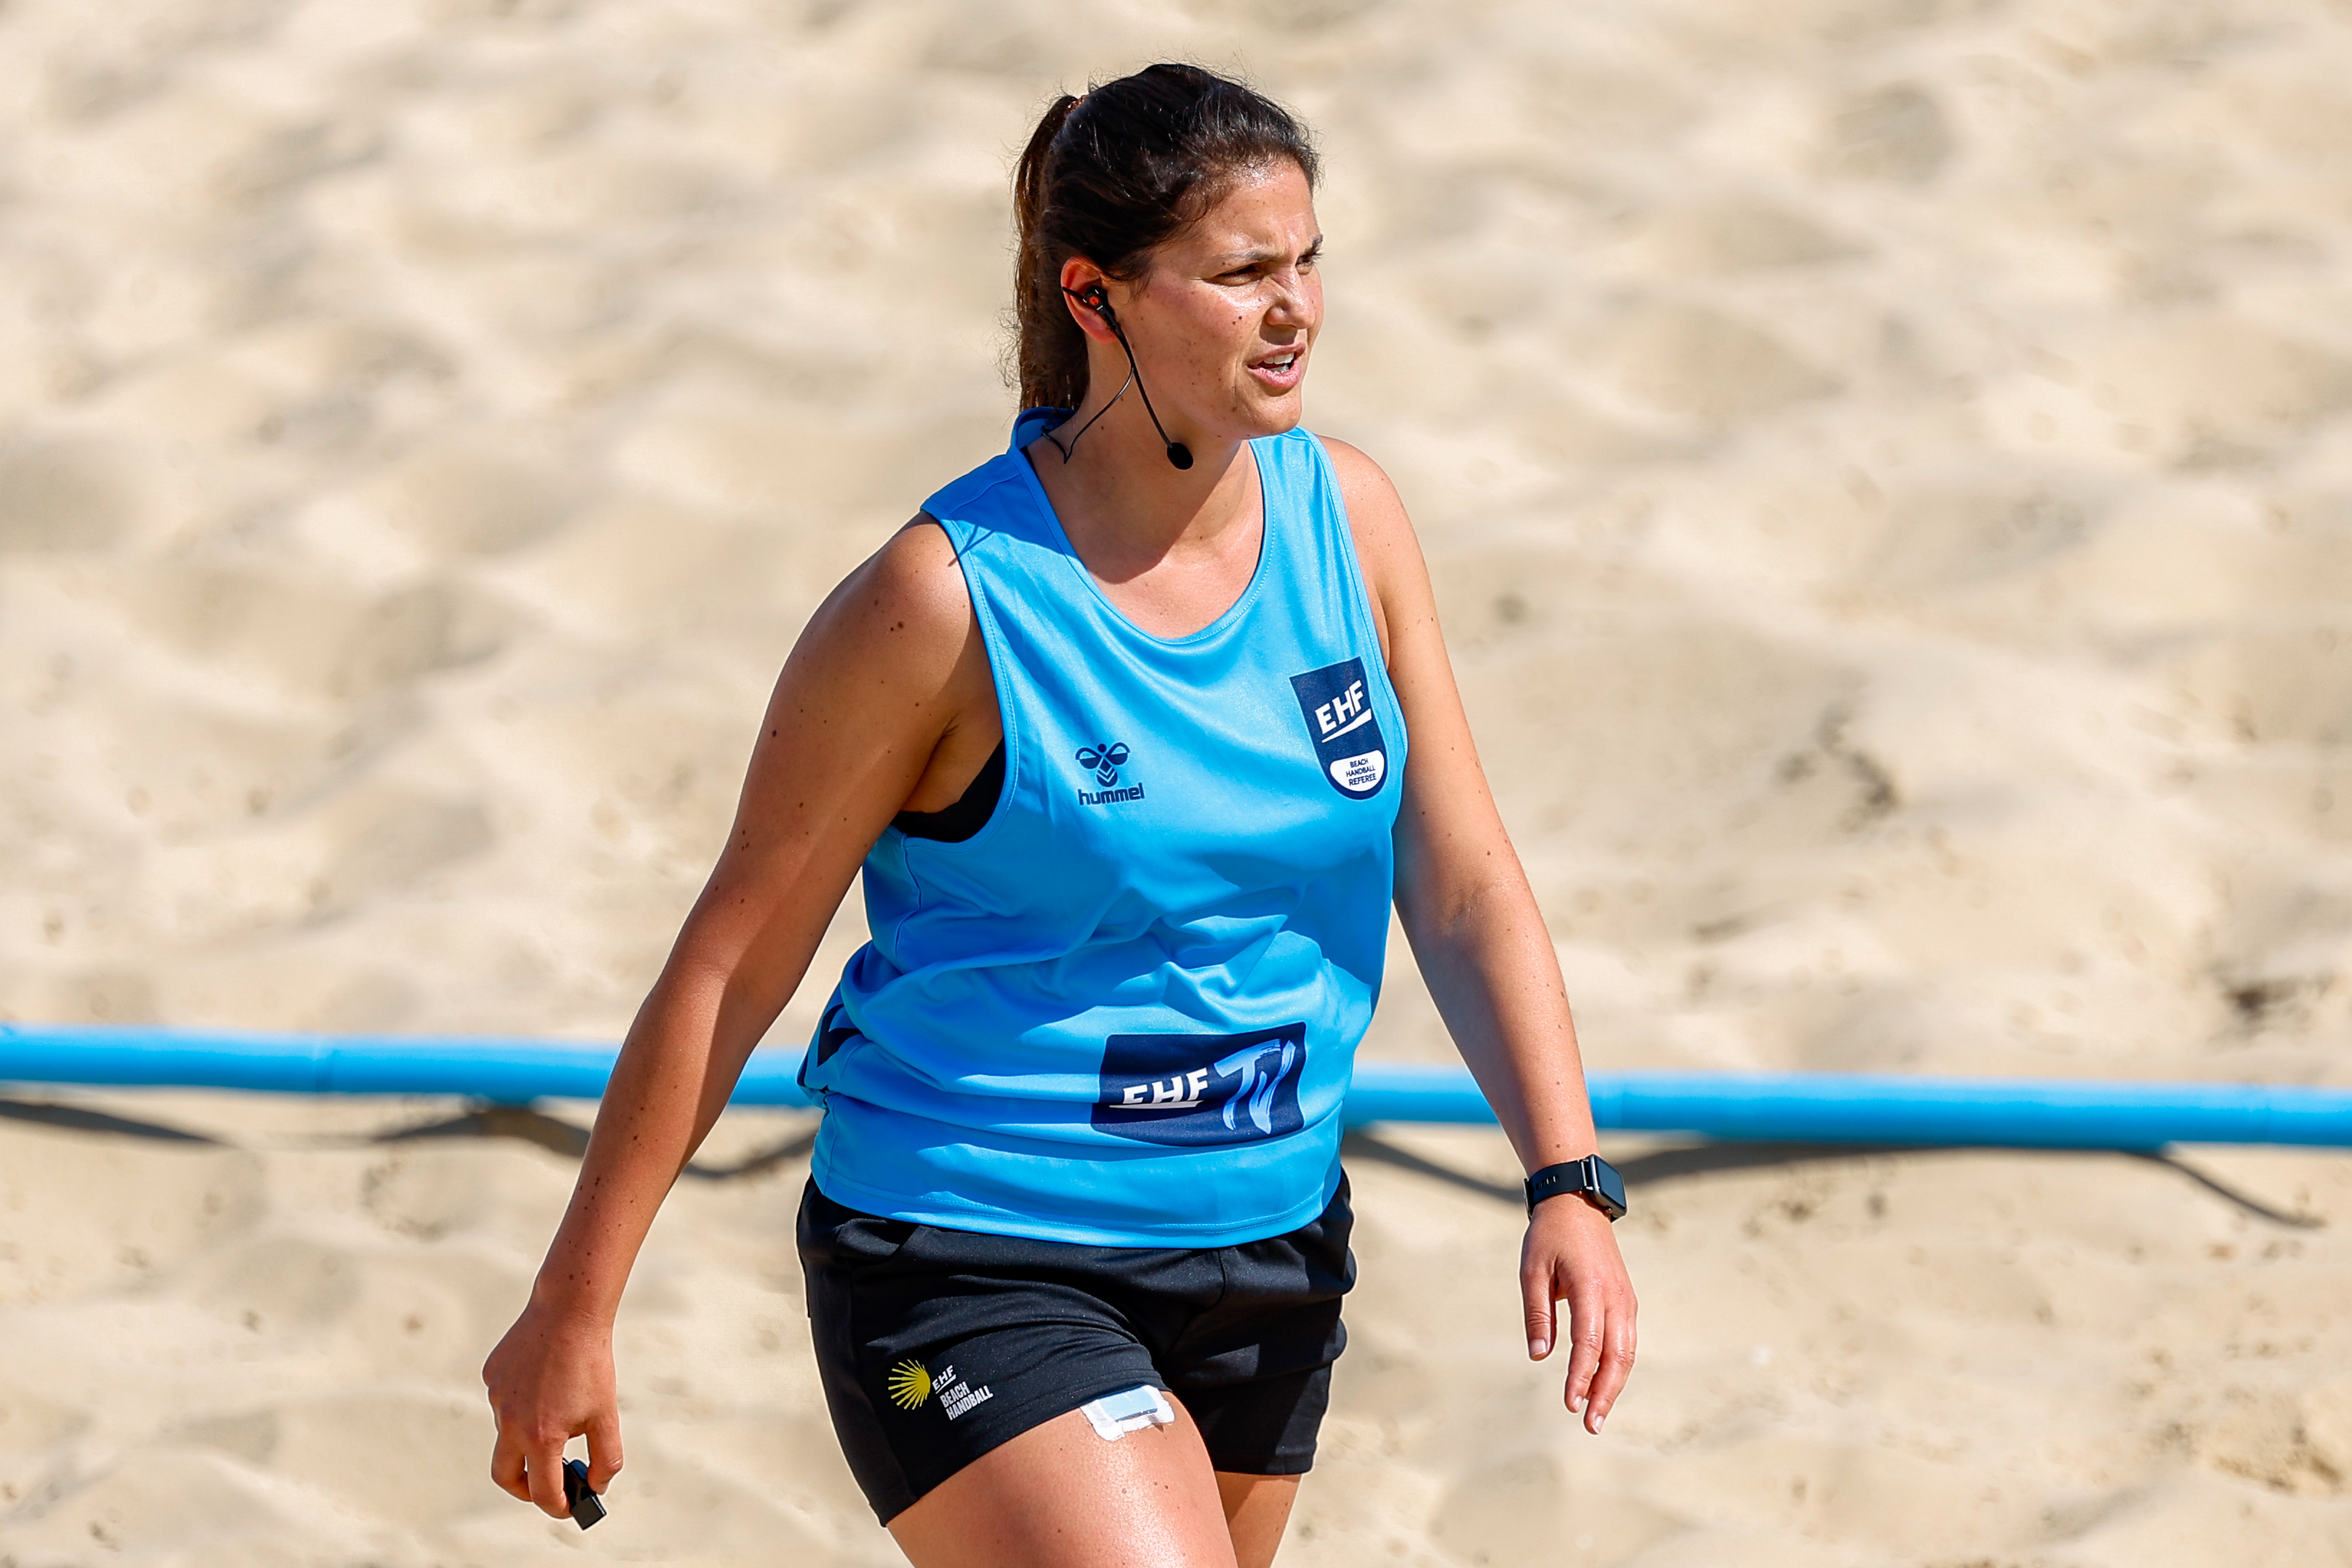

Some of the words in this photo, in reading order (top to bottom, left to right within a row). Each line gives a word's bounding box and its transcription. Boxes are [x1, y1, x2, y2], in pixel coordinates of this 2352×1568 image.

[1315, 679, 1363, 734] EHF
[1346, 765, 1376, 777] HANDBALL
[1350, 759, 1369, 768] BEACH
[1348, 774, 1376, 786] REFEREE
[1078, 782, 1144, 805] hummel
[1122, 1067, 1208, 1105] EHF
[932, 1365, 954, 1391] EHF
[940, 1381, 971, 1408] BEACH
[945, 1385, 994, 1421] HANDBALL
